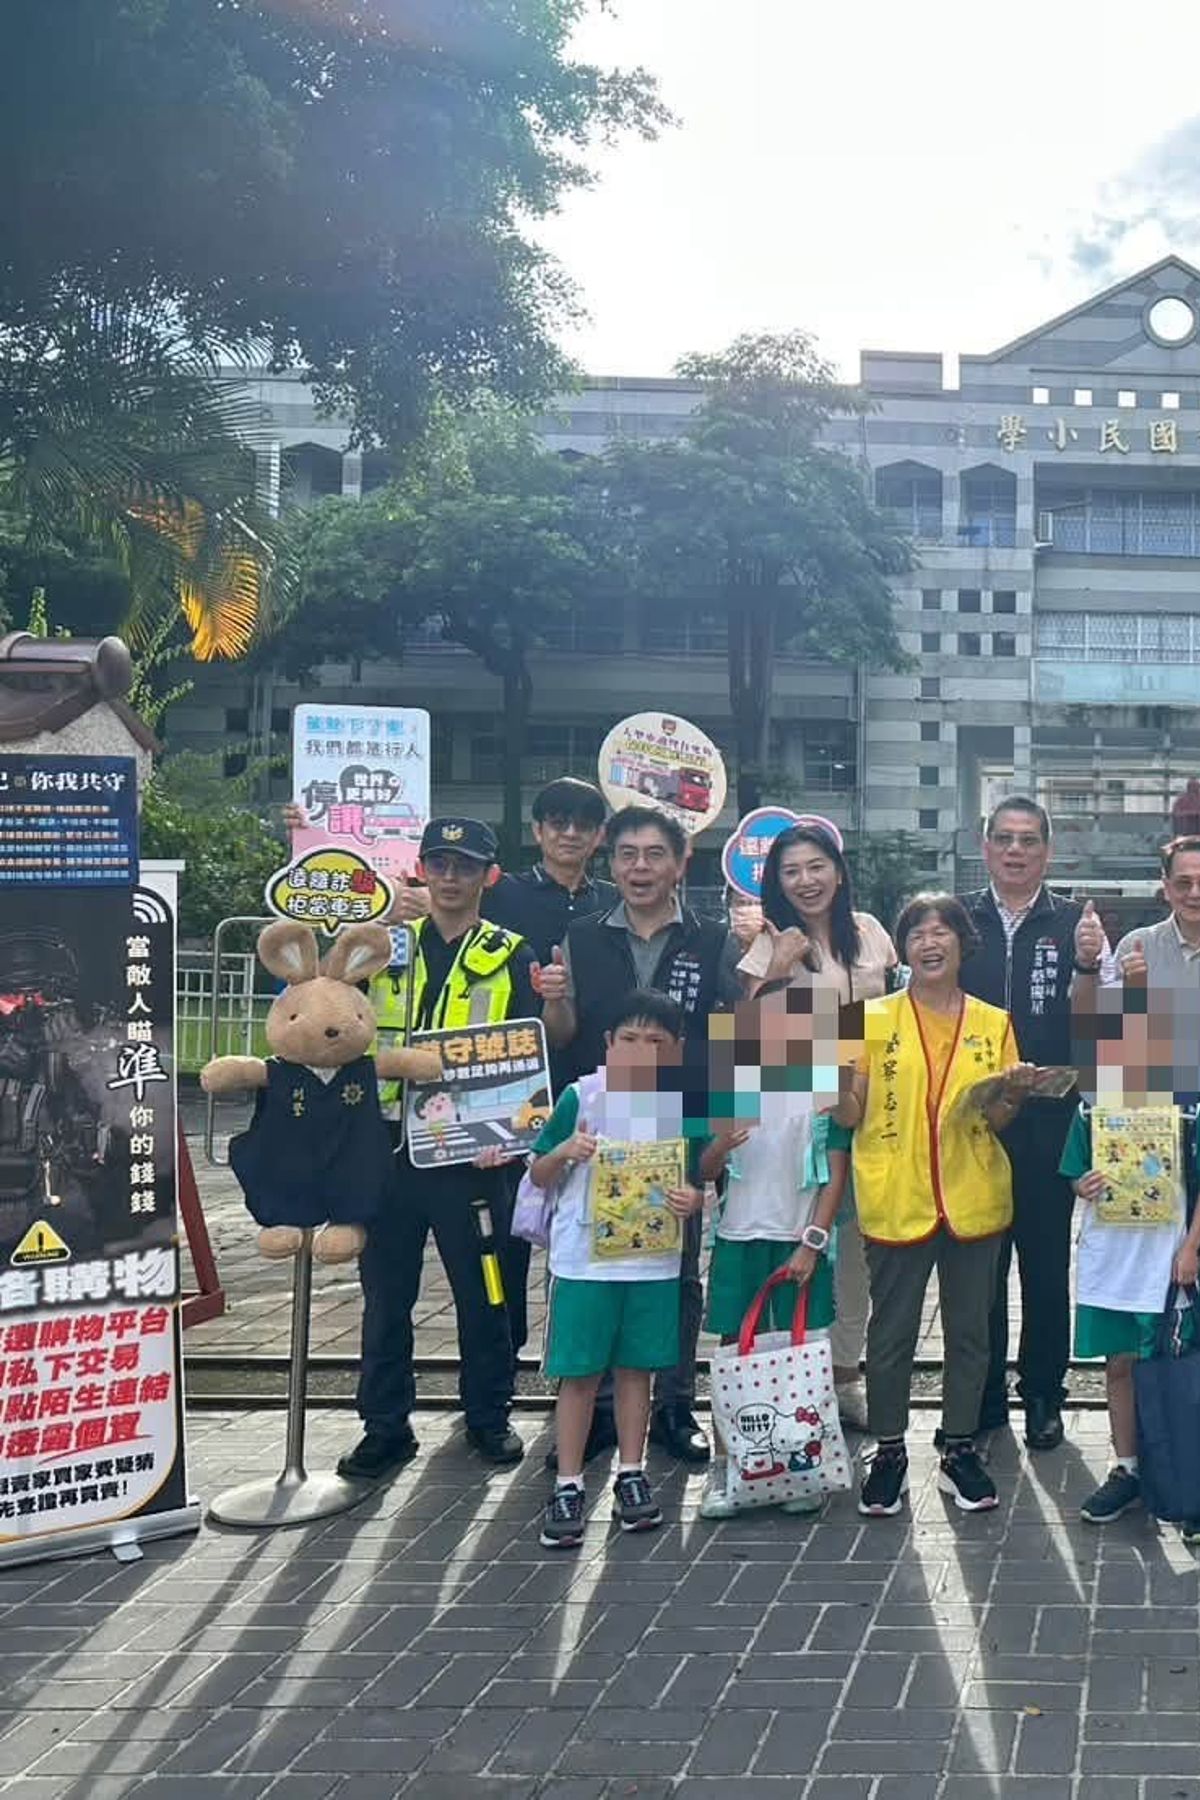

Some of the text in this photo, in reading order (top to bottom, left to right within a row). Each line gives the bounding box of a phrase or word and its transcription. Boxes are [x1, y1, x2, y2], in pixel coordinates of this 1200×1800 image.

[31, 771, 126, 791] 你我共守
[287, 895, 372, 918] 拒當車手
[0, 1307, 169, 1352] 選購物平台
[0, 1343, 140, 1388] 私下交易
[0, 1372, 171, 1423] 點陌生連結
[740, 1413, 770, 1423] HELLO
[0, 1412, 141, 1458] 透露個資
